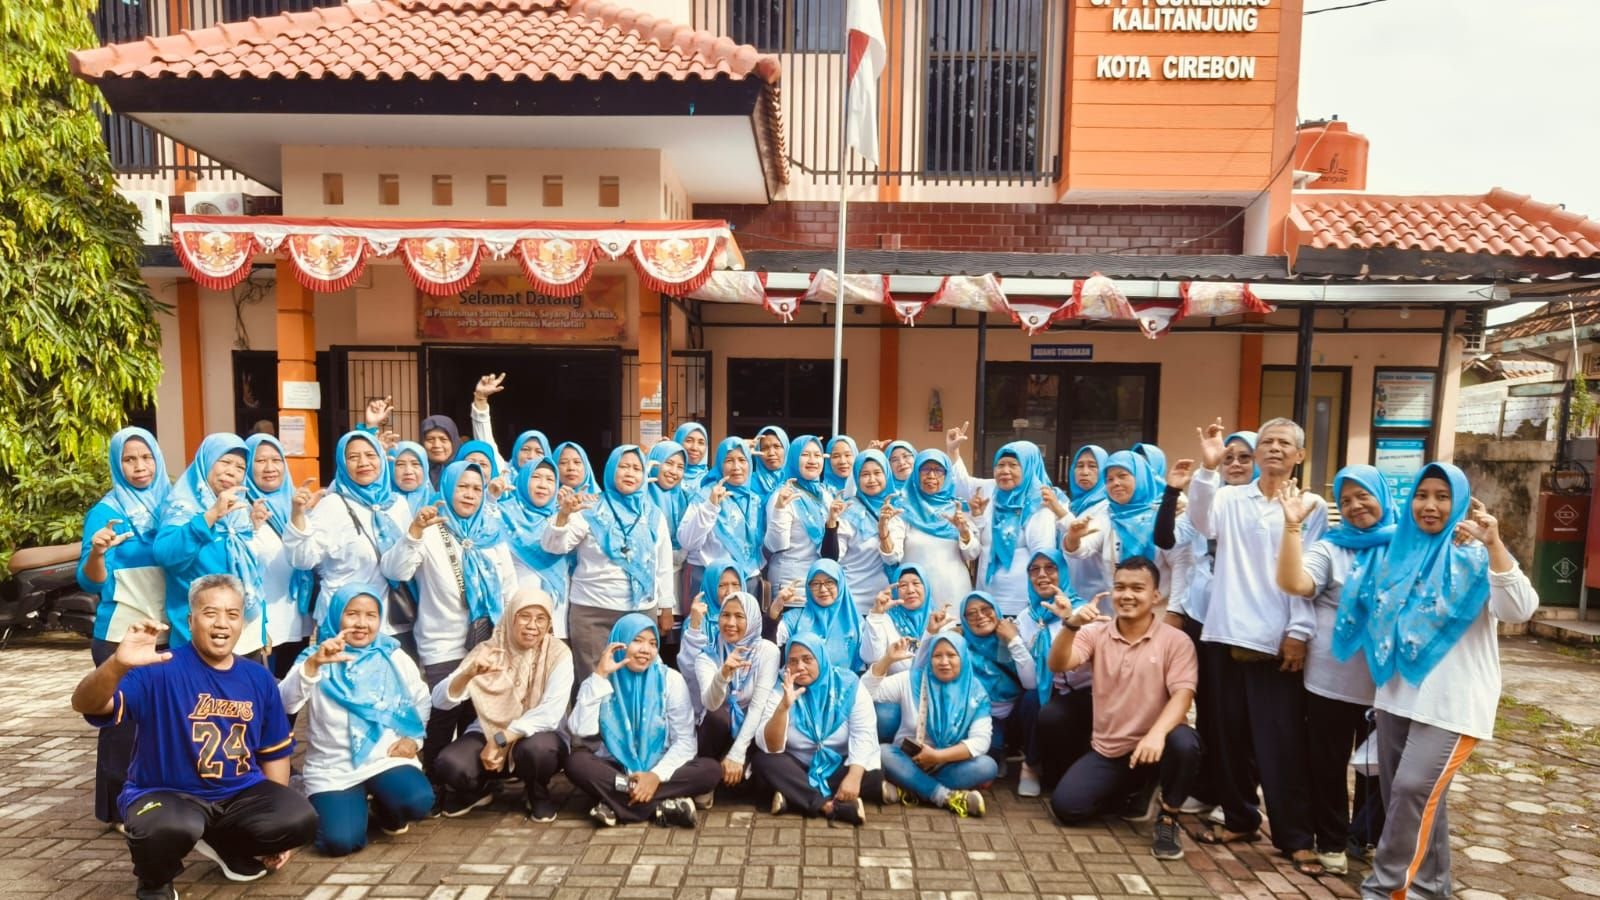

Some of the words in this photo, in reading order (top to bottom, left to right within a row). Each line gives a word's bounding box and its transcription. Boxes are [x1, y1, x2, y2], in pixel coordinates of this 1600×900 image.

[1112, 8, 1259, 32] KALITANJUNG
[1096, 55, 1152, 79] KOTA
[1162, 55, 1256, 80] CIREBON
[458, 291, 521, 305] Selamat
[526, 291, 582, 308] Datang
[502, 319, 540, 327] Informasi
[542, 319, 585, 327] Kesehatan
[188, 693, 253, 721] LAKERS
[192, 721, 251, 779] 24
